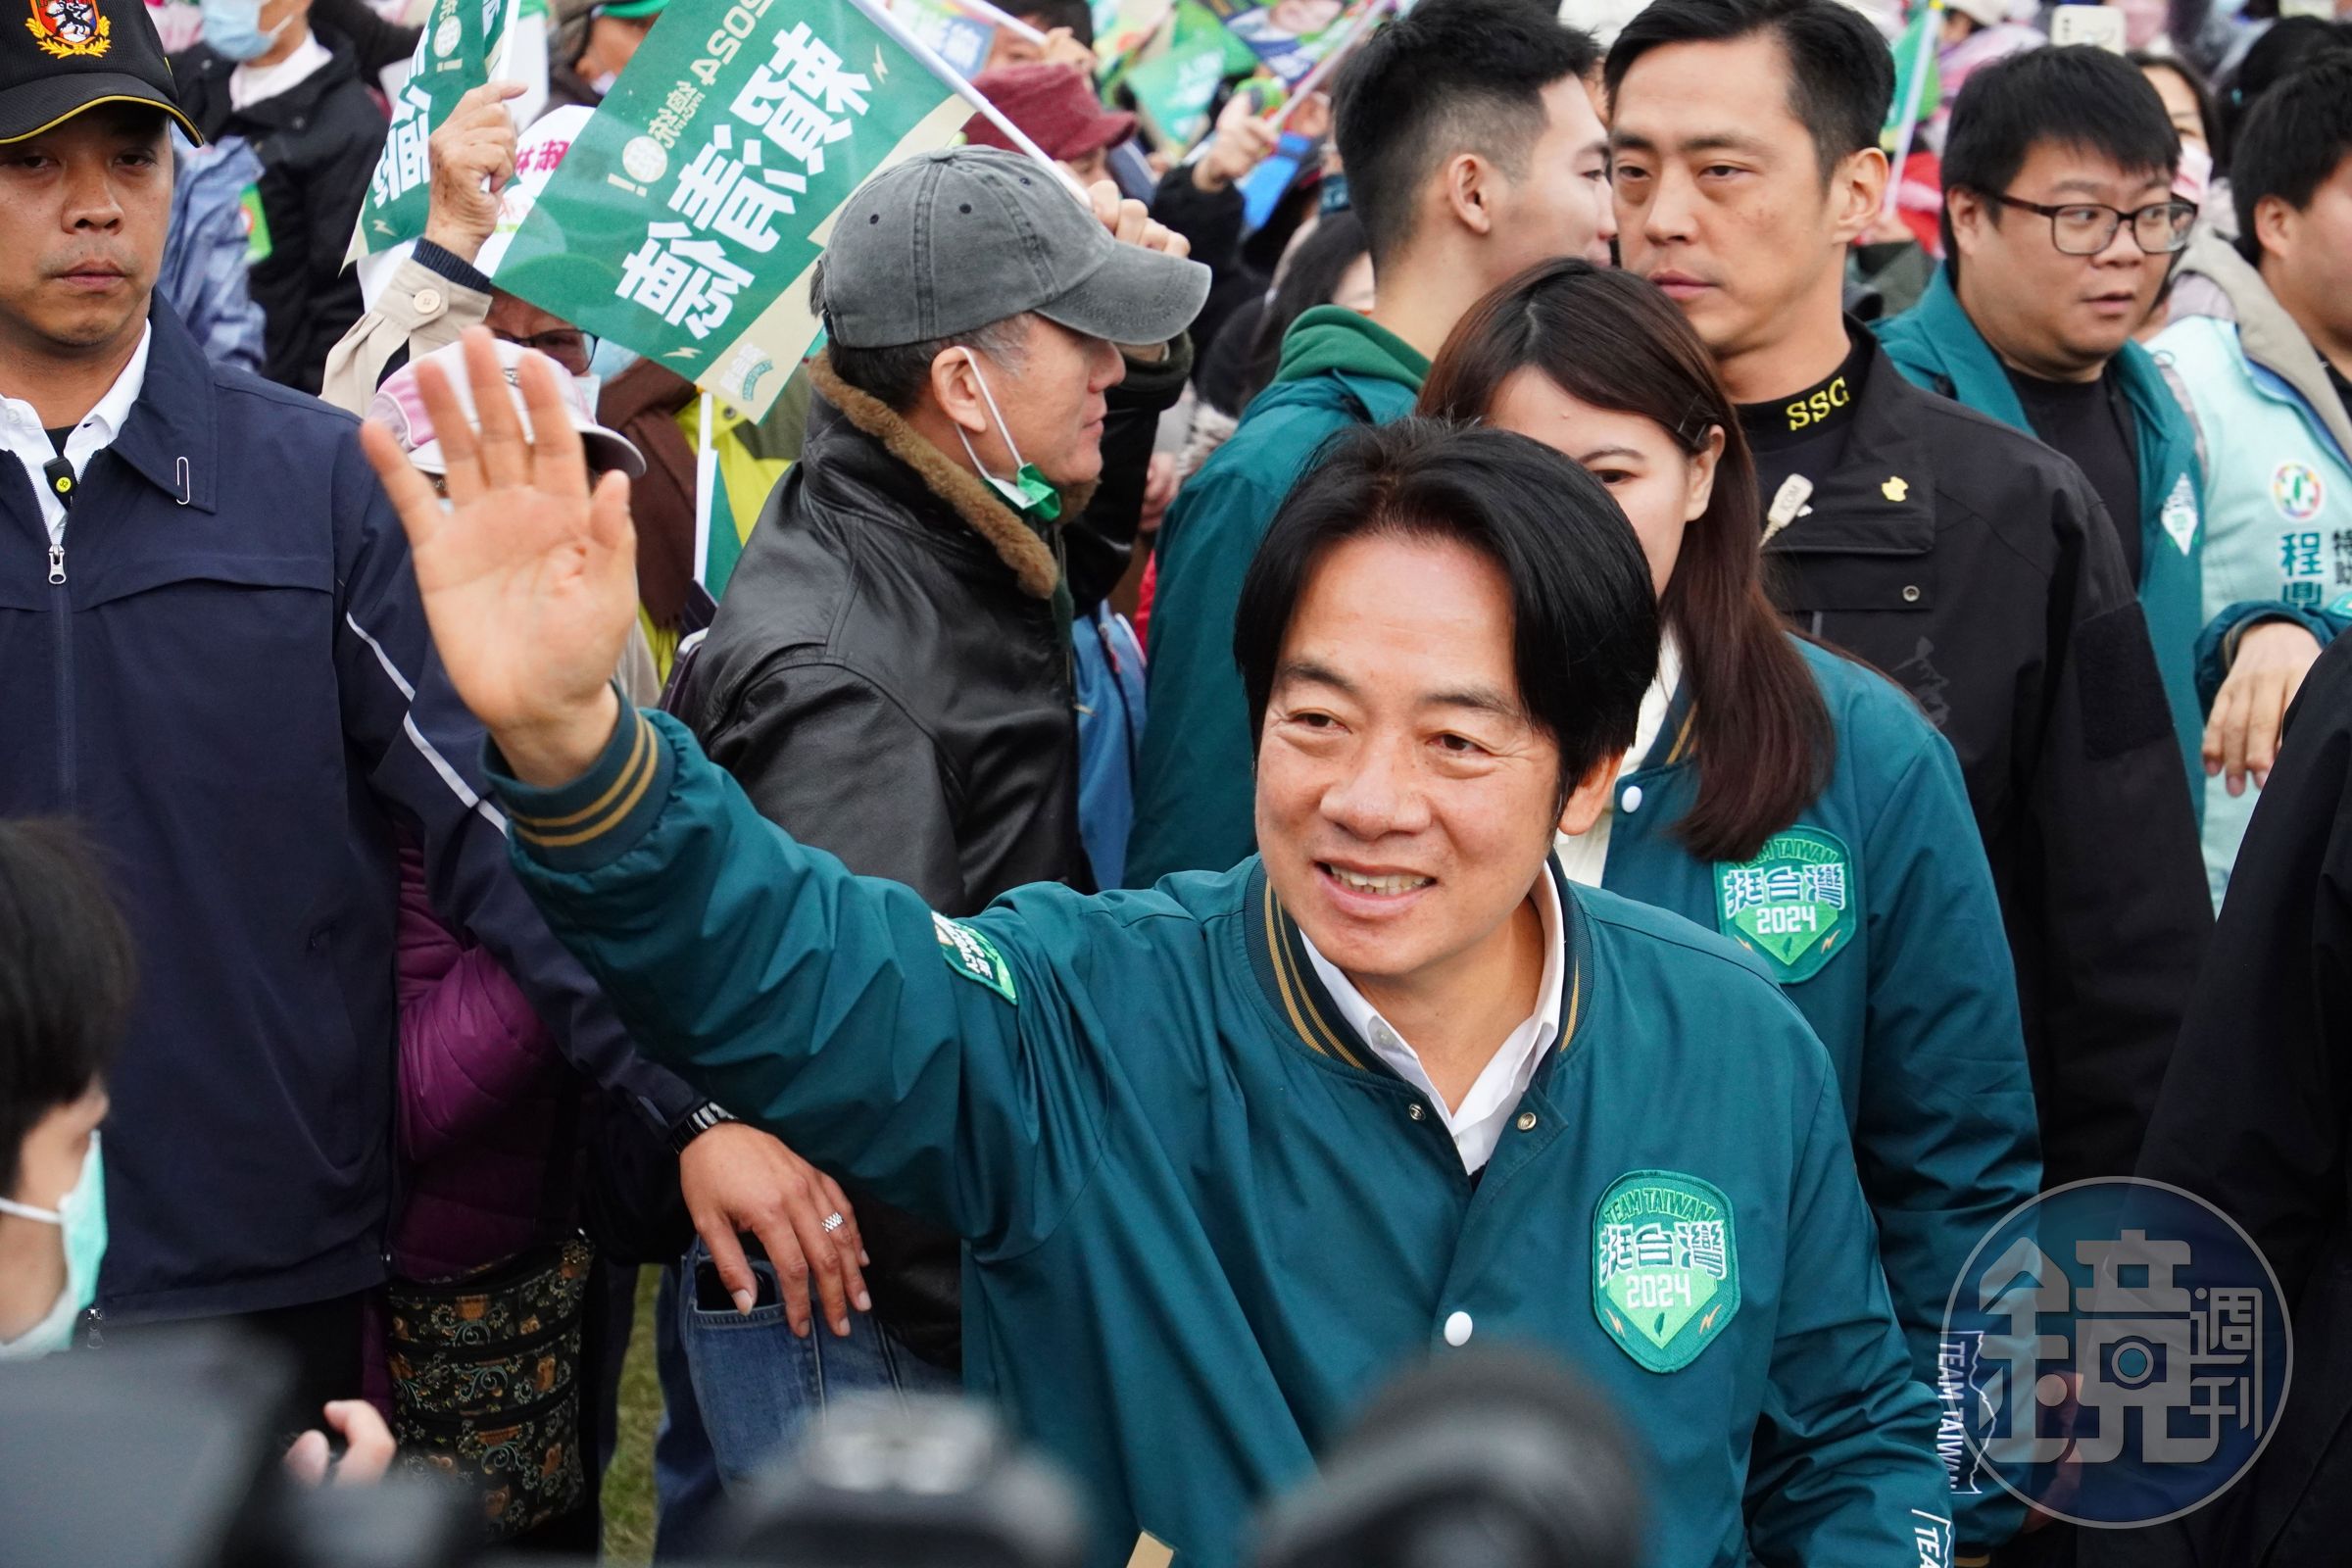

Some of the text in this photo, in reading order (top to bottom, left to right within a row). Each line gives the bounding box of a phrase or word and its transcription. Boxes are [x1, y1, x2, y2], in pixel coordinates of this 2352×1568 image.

[1775, 838, 1838, 864] TAIWAN
[1723, 862, 1845, 919] 挺台灣
[1756, 906, 1817, 934] 2024
[1604, 1187, 1717, 1224] TEAM TAIWAN
[1599, 1220, 1727, 1289] 挺台灣
[1626, 1274, 1691, 1309] 2024
[1936, 1341, 1966, 1490] TEAM TAIW
